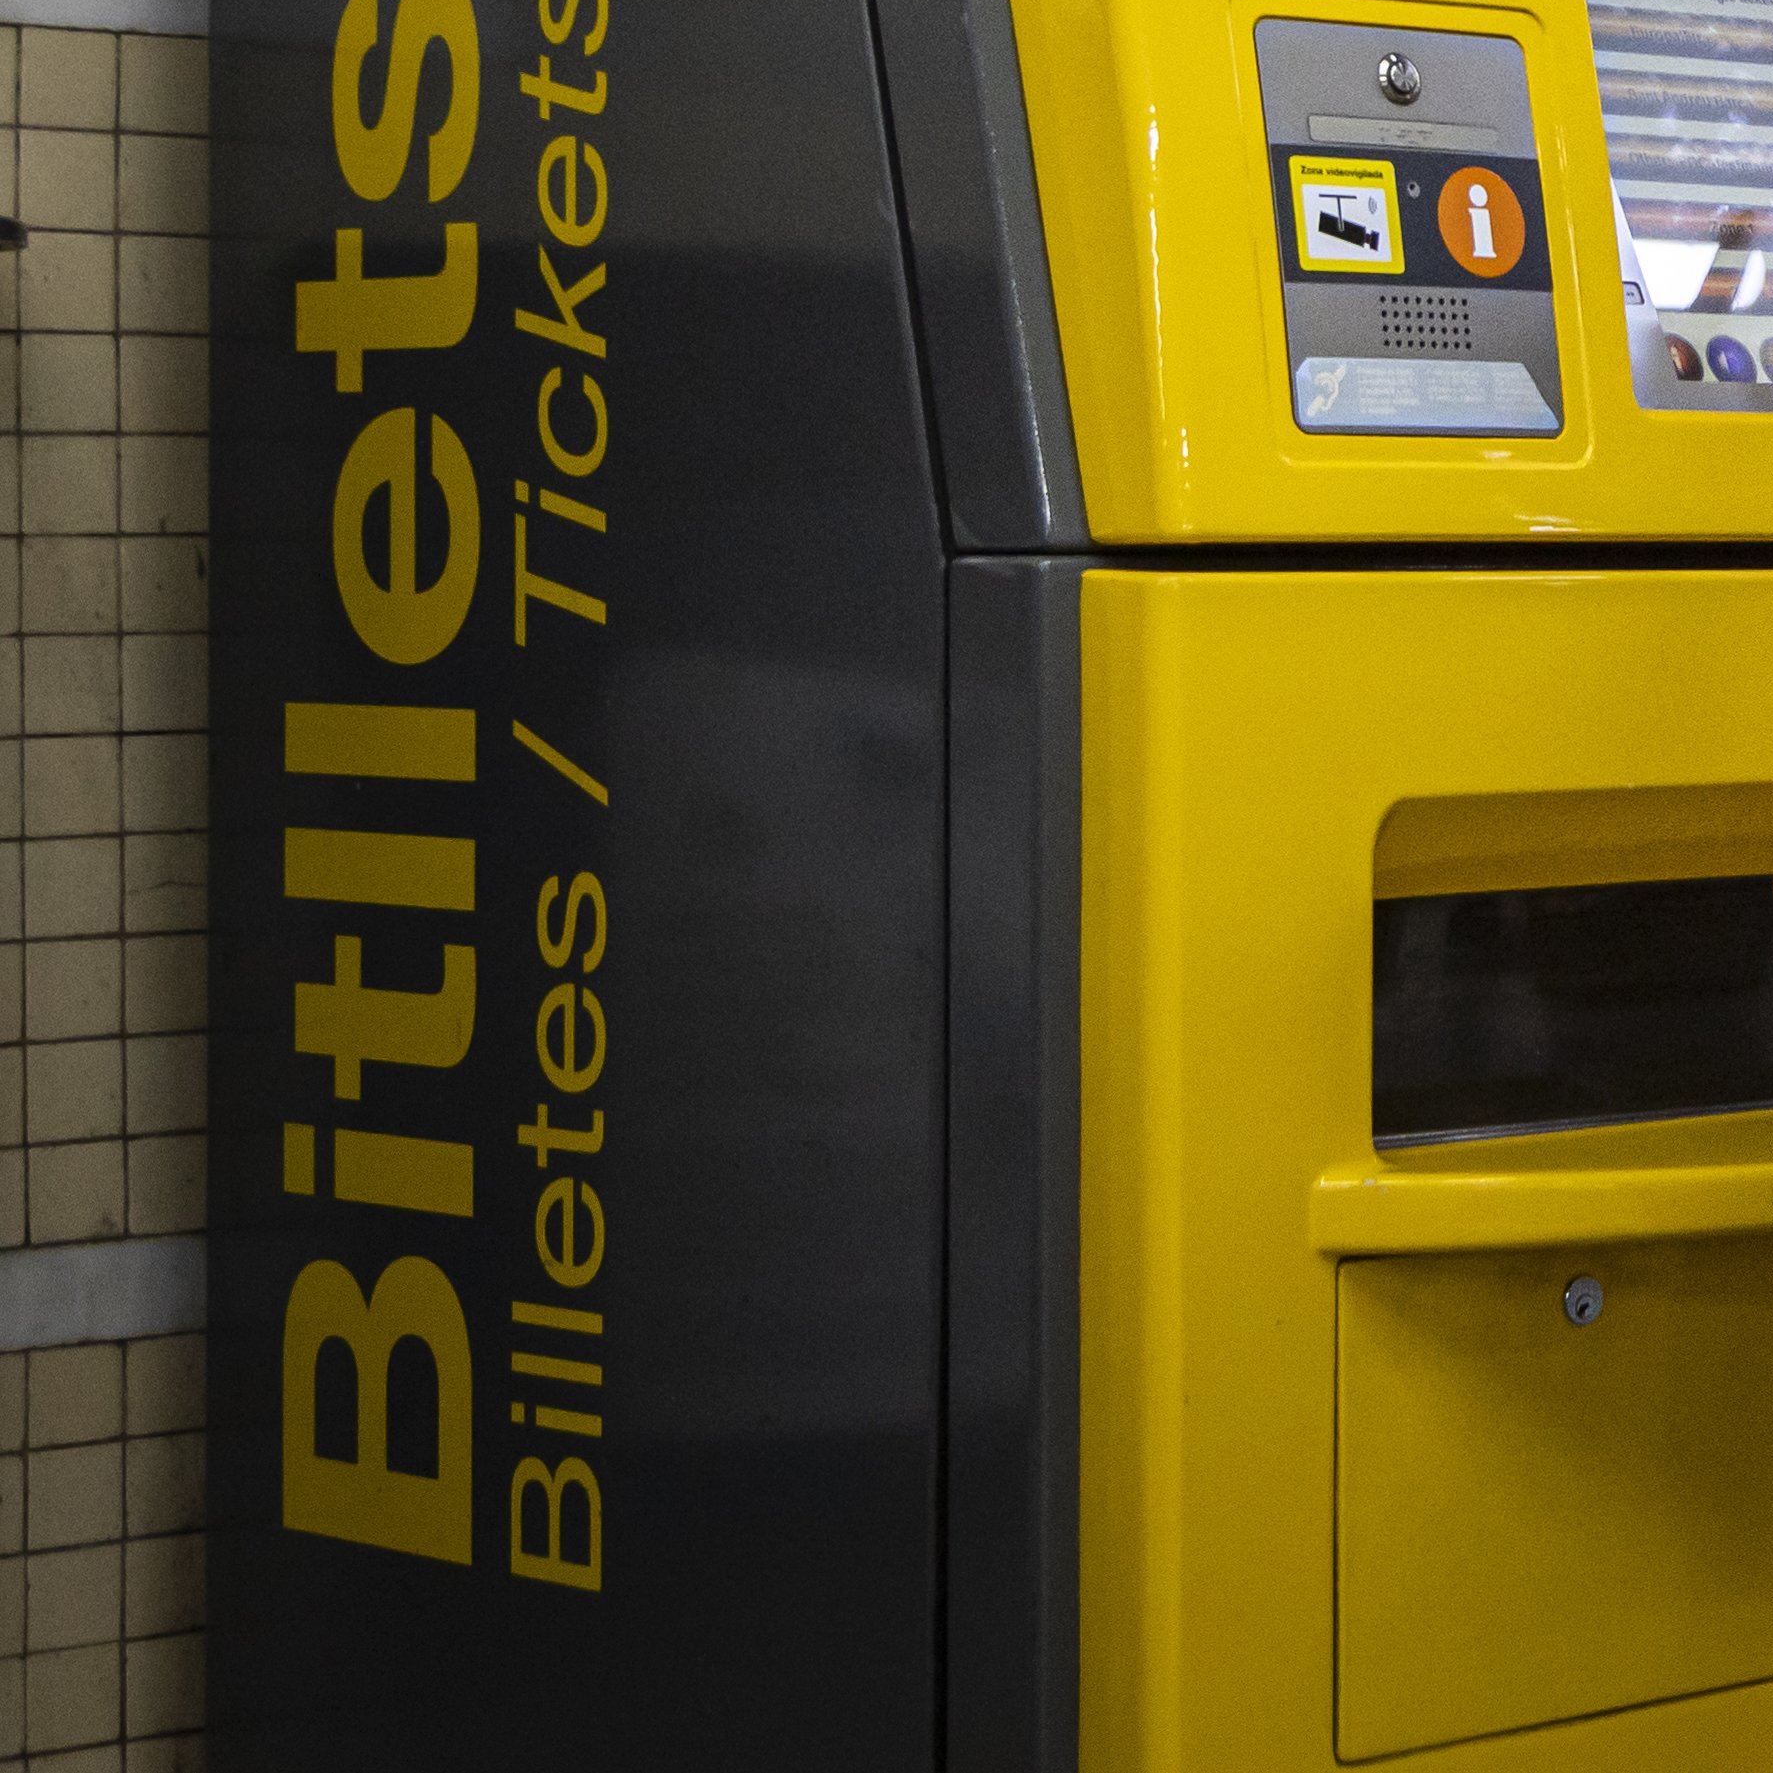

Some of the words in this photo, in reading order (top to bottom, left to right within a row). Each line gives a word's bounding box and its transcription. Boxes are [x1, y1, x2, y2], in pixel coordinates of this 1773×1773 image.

[1300, 165, 1323, 176] Zona
[1327, 166, 1383, 180] videovigilada
[512, 718, 609, 808] /
[511, 870, 608, 1592] Billetes
